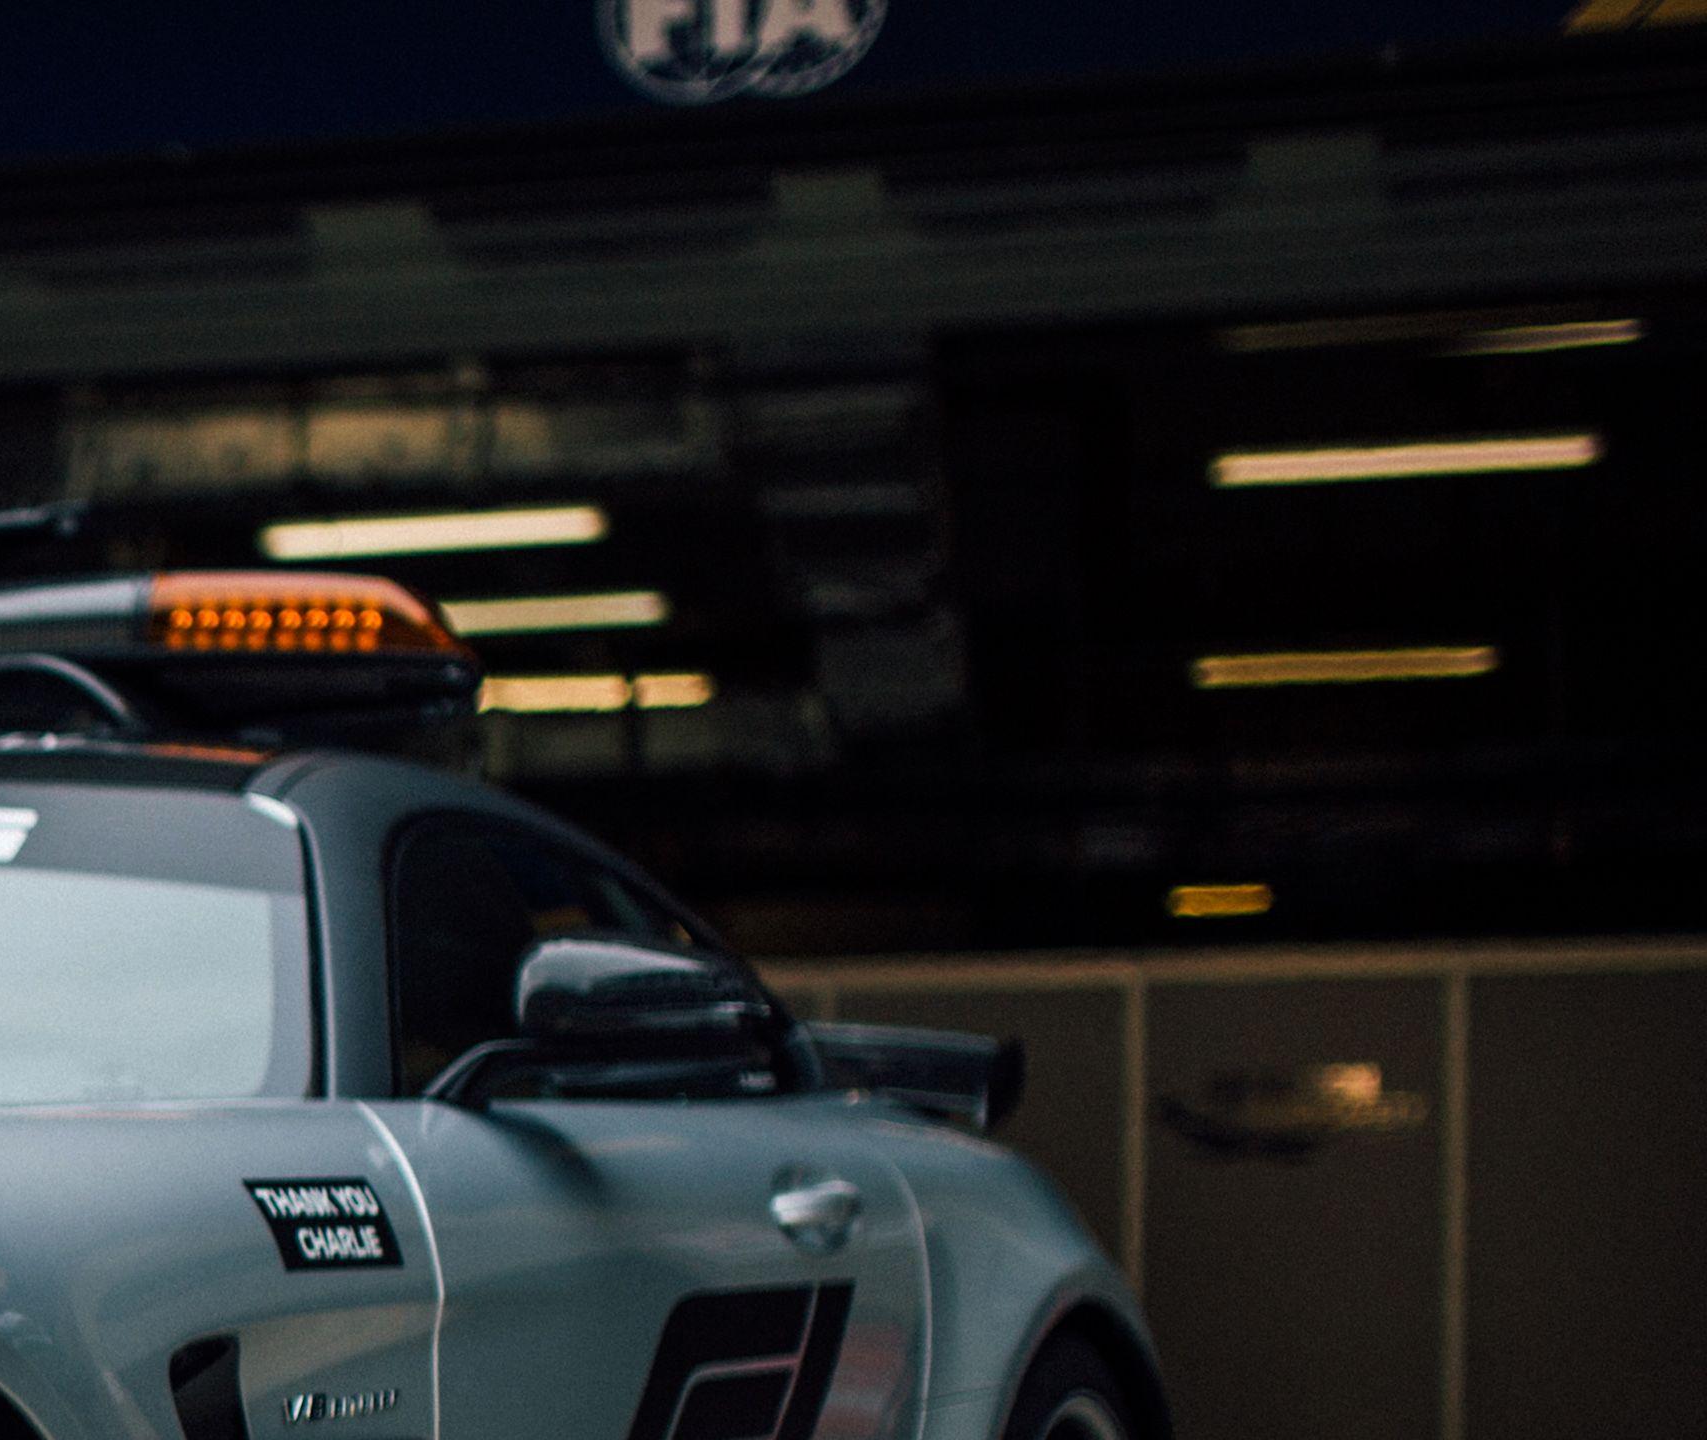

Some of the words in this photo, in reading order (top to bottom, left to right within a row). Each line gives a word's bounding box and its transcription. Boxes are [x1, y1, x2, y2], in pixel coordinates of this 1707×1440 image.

[254, 1186, 339, 1217] THANK
[330, 1185, 380, 1217] YOU
[297, 1225, 384, 1260] CHARLIE
